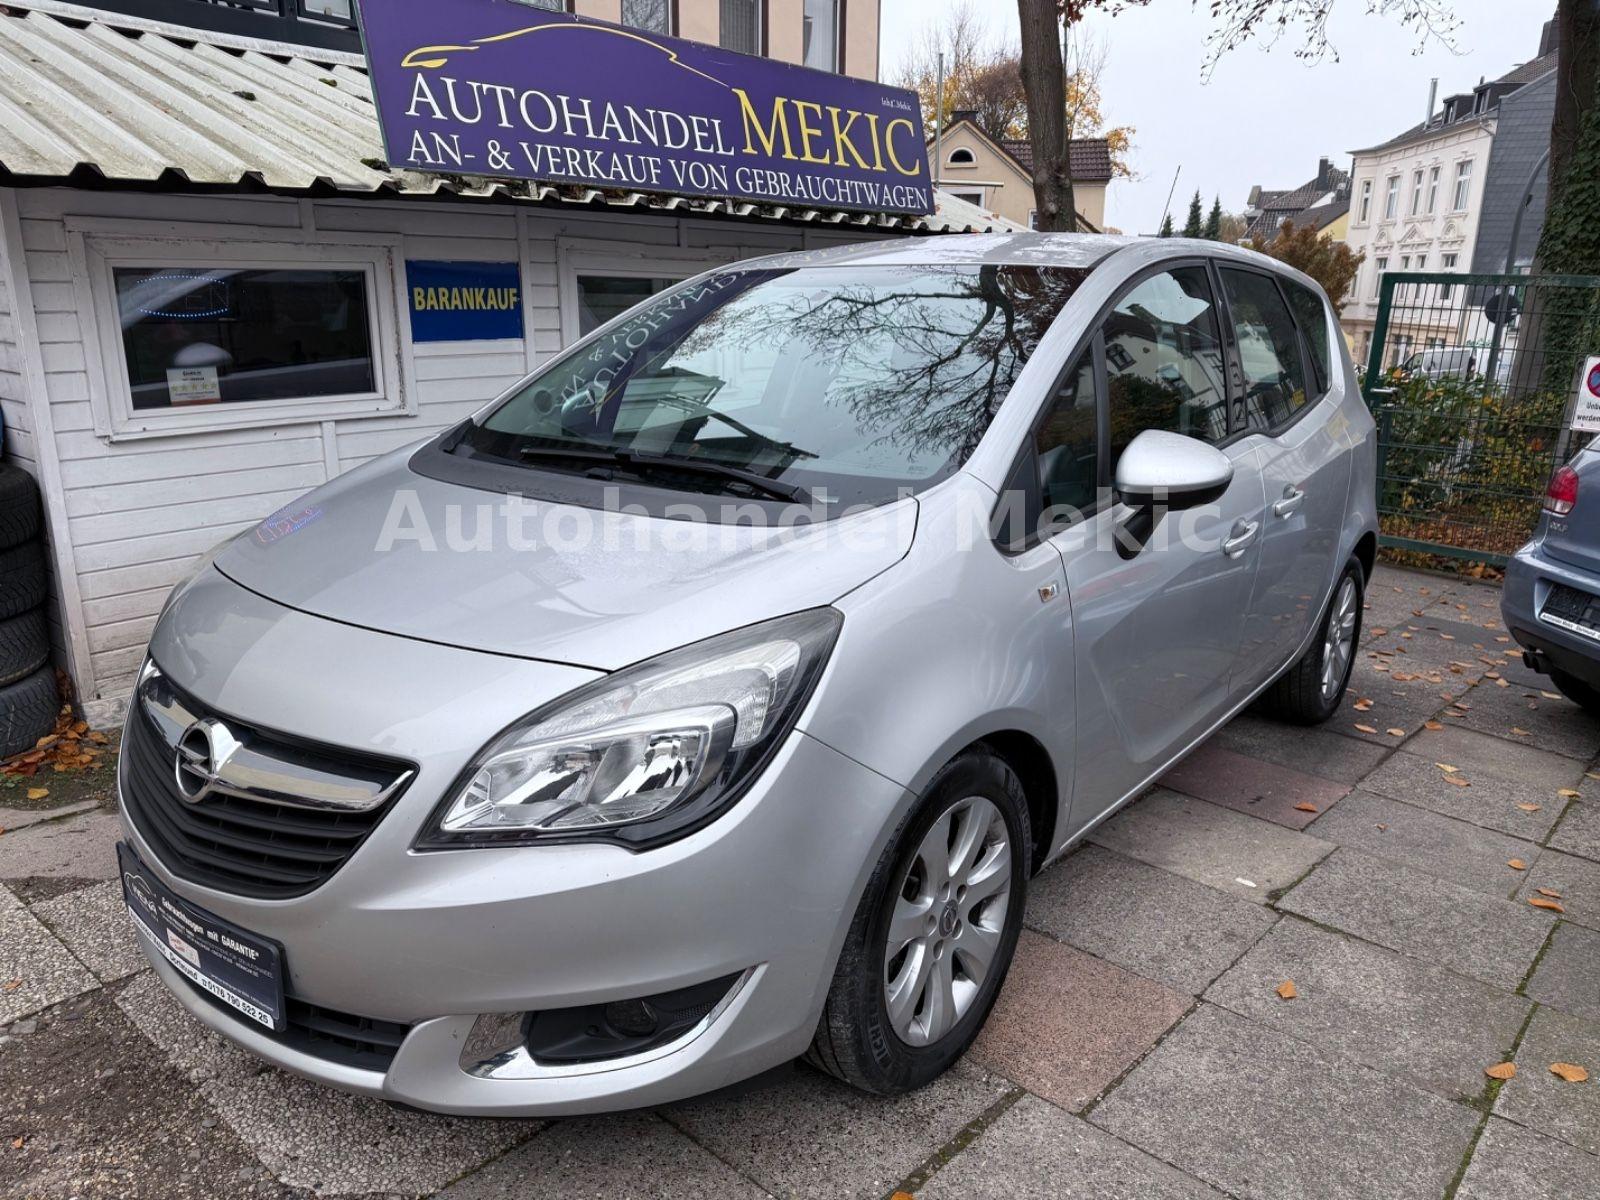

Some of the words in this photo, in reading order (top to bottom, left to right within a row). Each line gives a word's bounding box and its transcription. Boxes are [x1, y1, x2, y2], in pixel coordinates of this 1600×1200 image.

[405, 72, 735, 156] AUTOHANDEL
[731, 88, 921, 176] MEKIC
[407, 129, 476, 166] AN-
[487, 139, 515, 170] &
[518, 141, 662, 185] VERKAUF
[667, 158, 729, 191] VON
[735, 167, 929, 210] GEBRAUCHTWAGEN
[412, 286, 518, 311] BARANKAUF
[207, 930, 219, 942] mit
